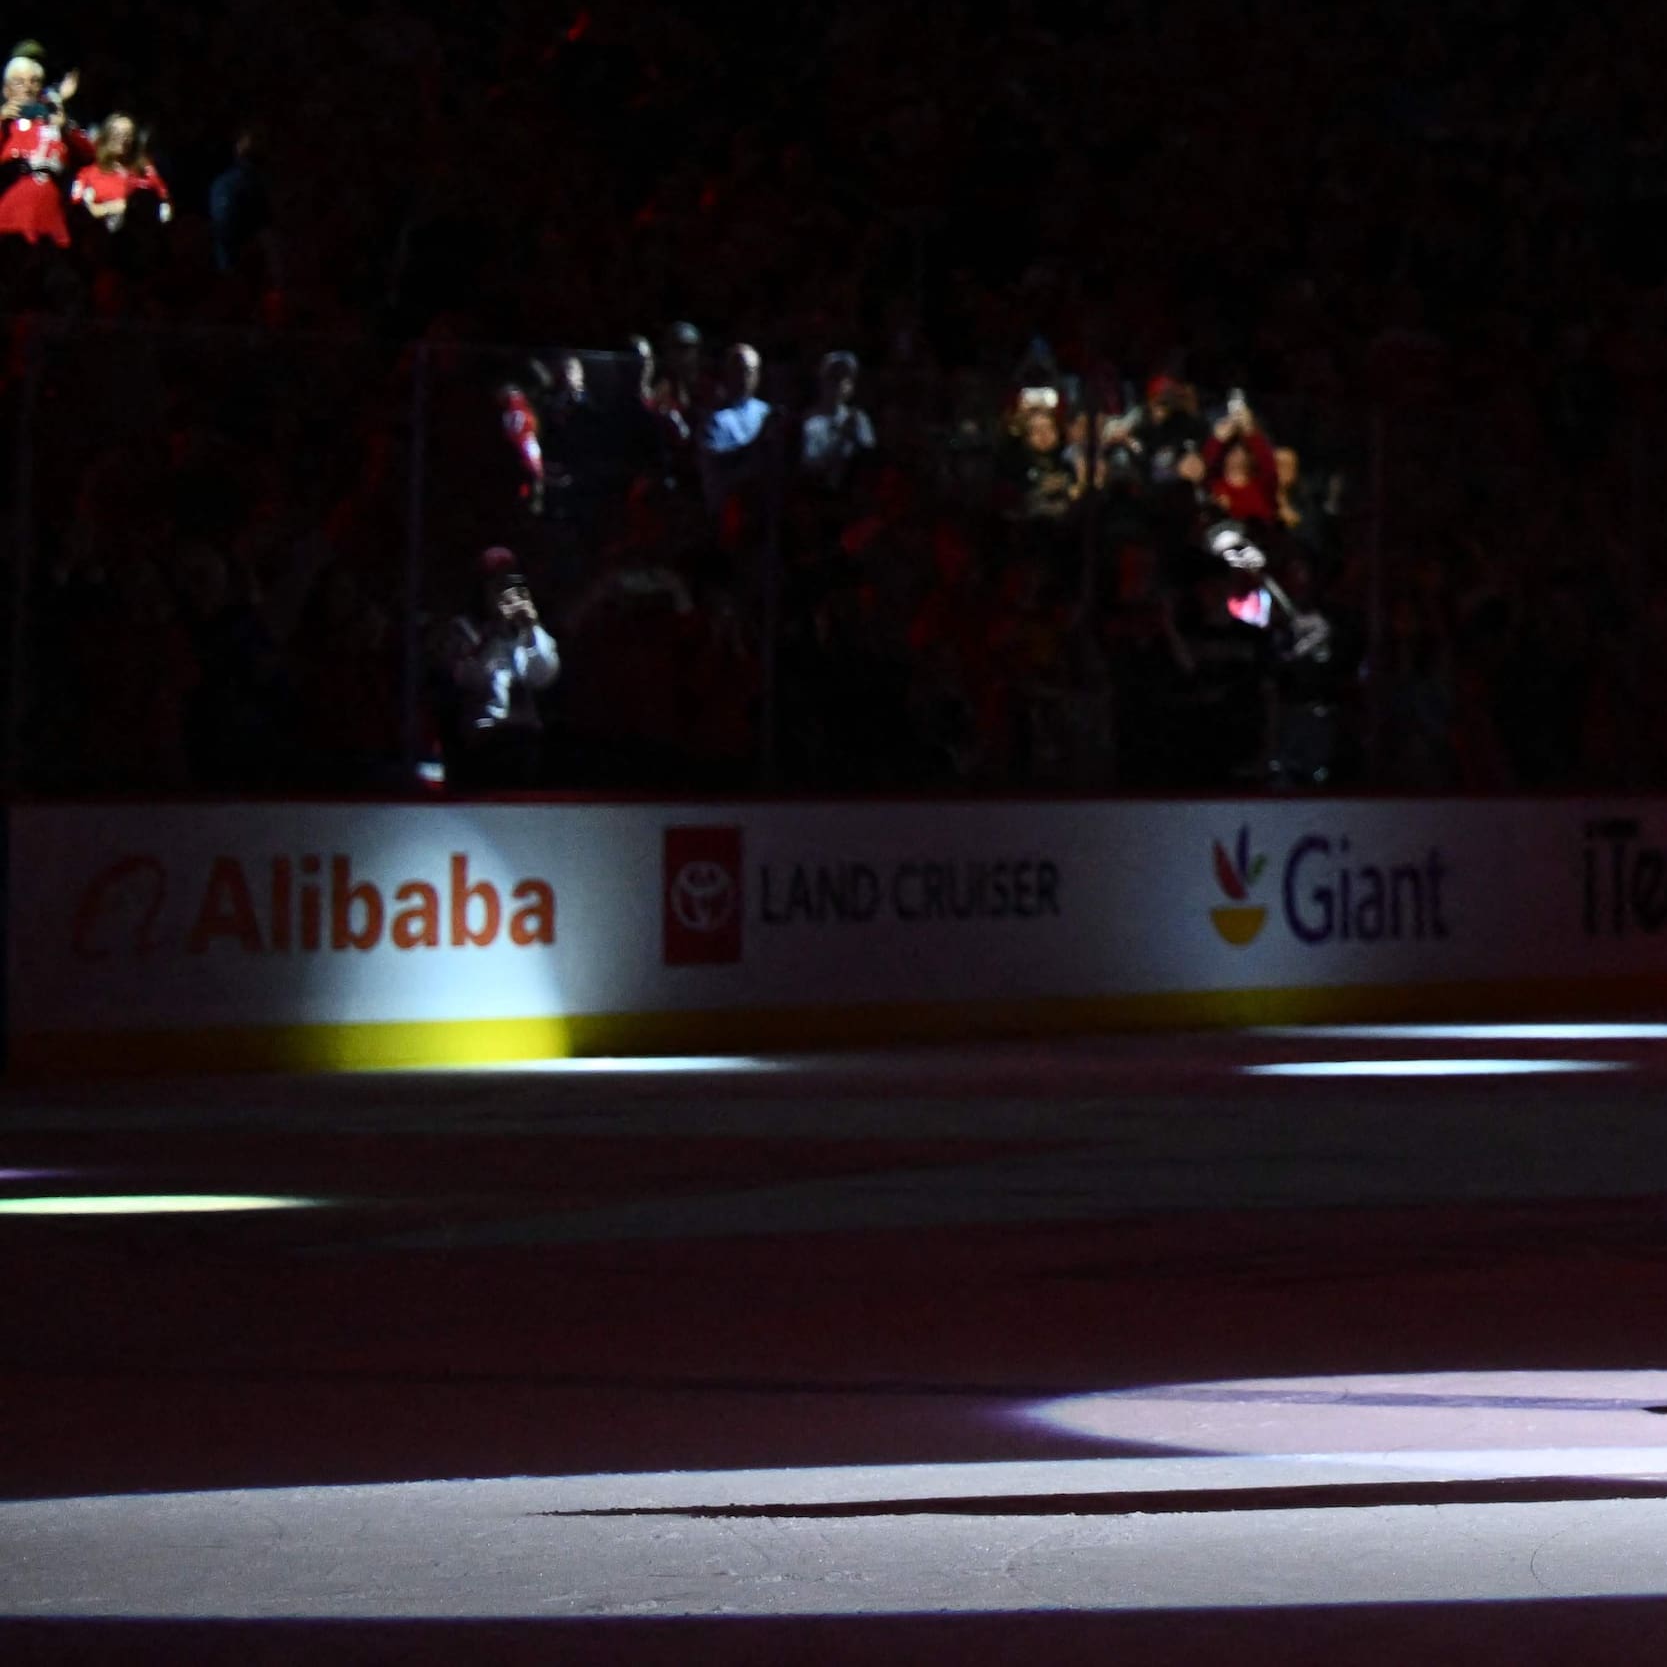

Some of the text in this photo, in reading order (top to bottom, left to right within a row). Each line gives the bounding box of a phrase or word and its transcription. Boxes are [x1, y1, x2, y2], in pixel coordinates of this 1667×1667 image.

[187, 852, 557, 955] Alibaba
[761, 860, 1060, 923] LAND CRUISER
[1282, 835, 1448, 944] Giant
